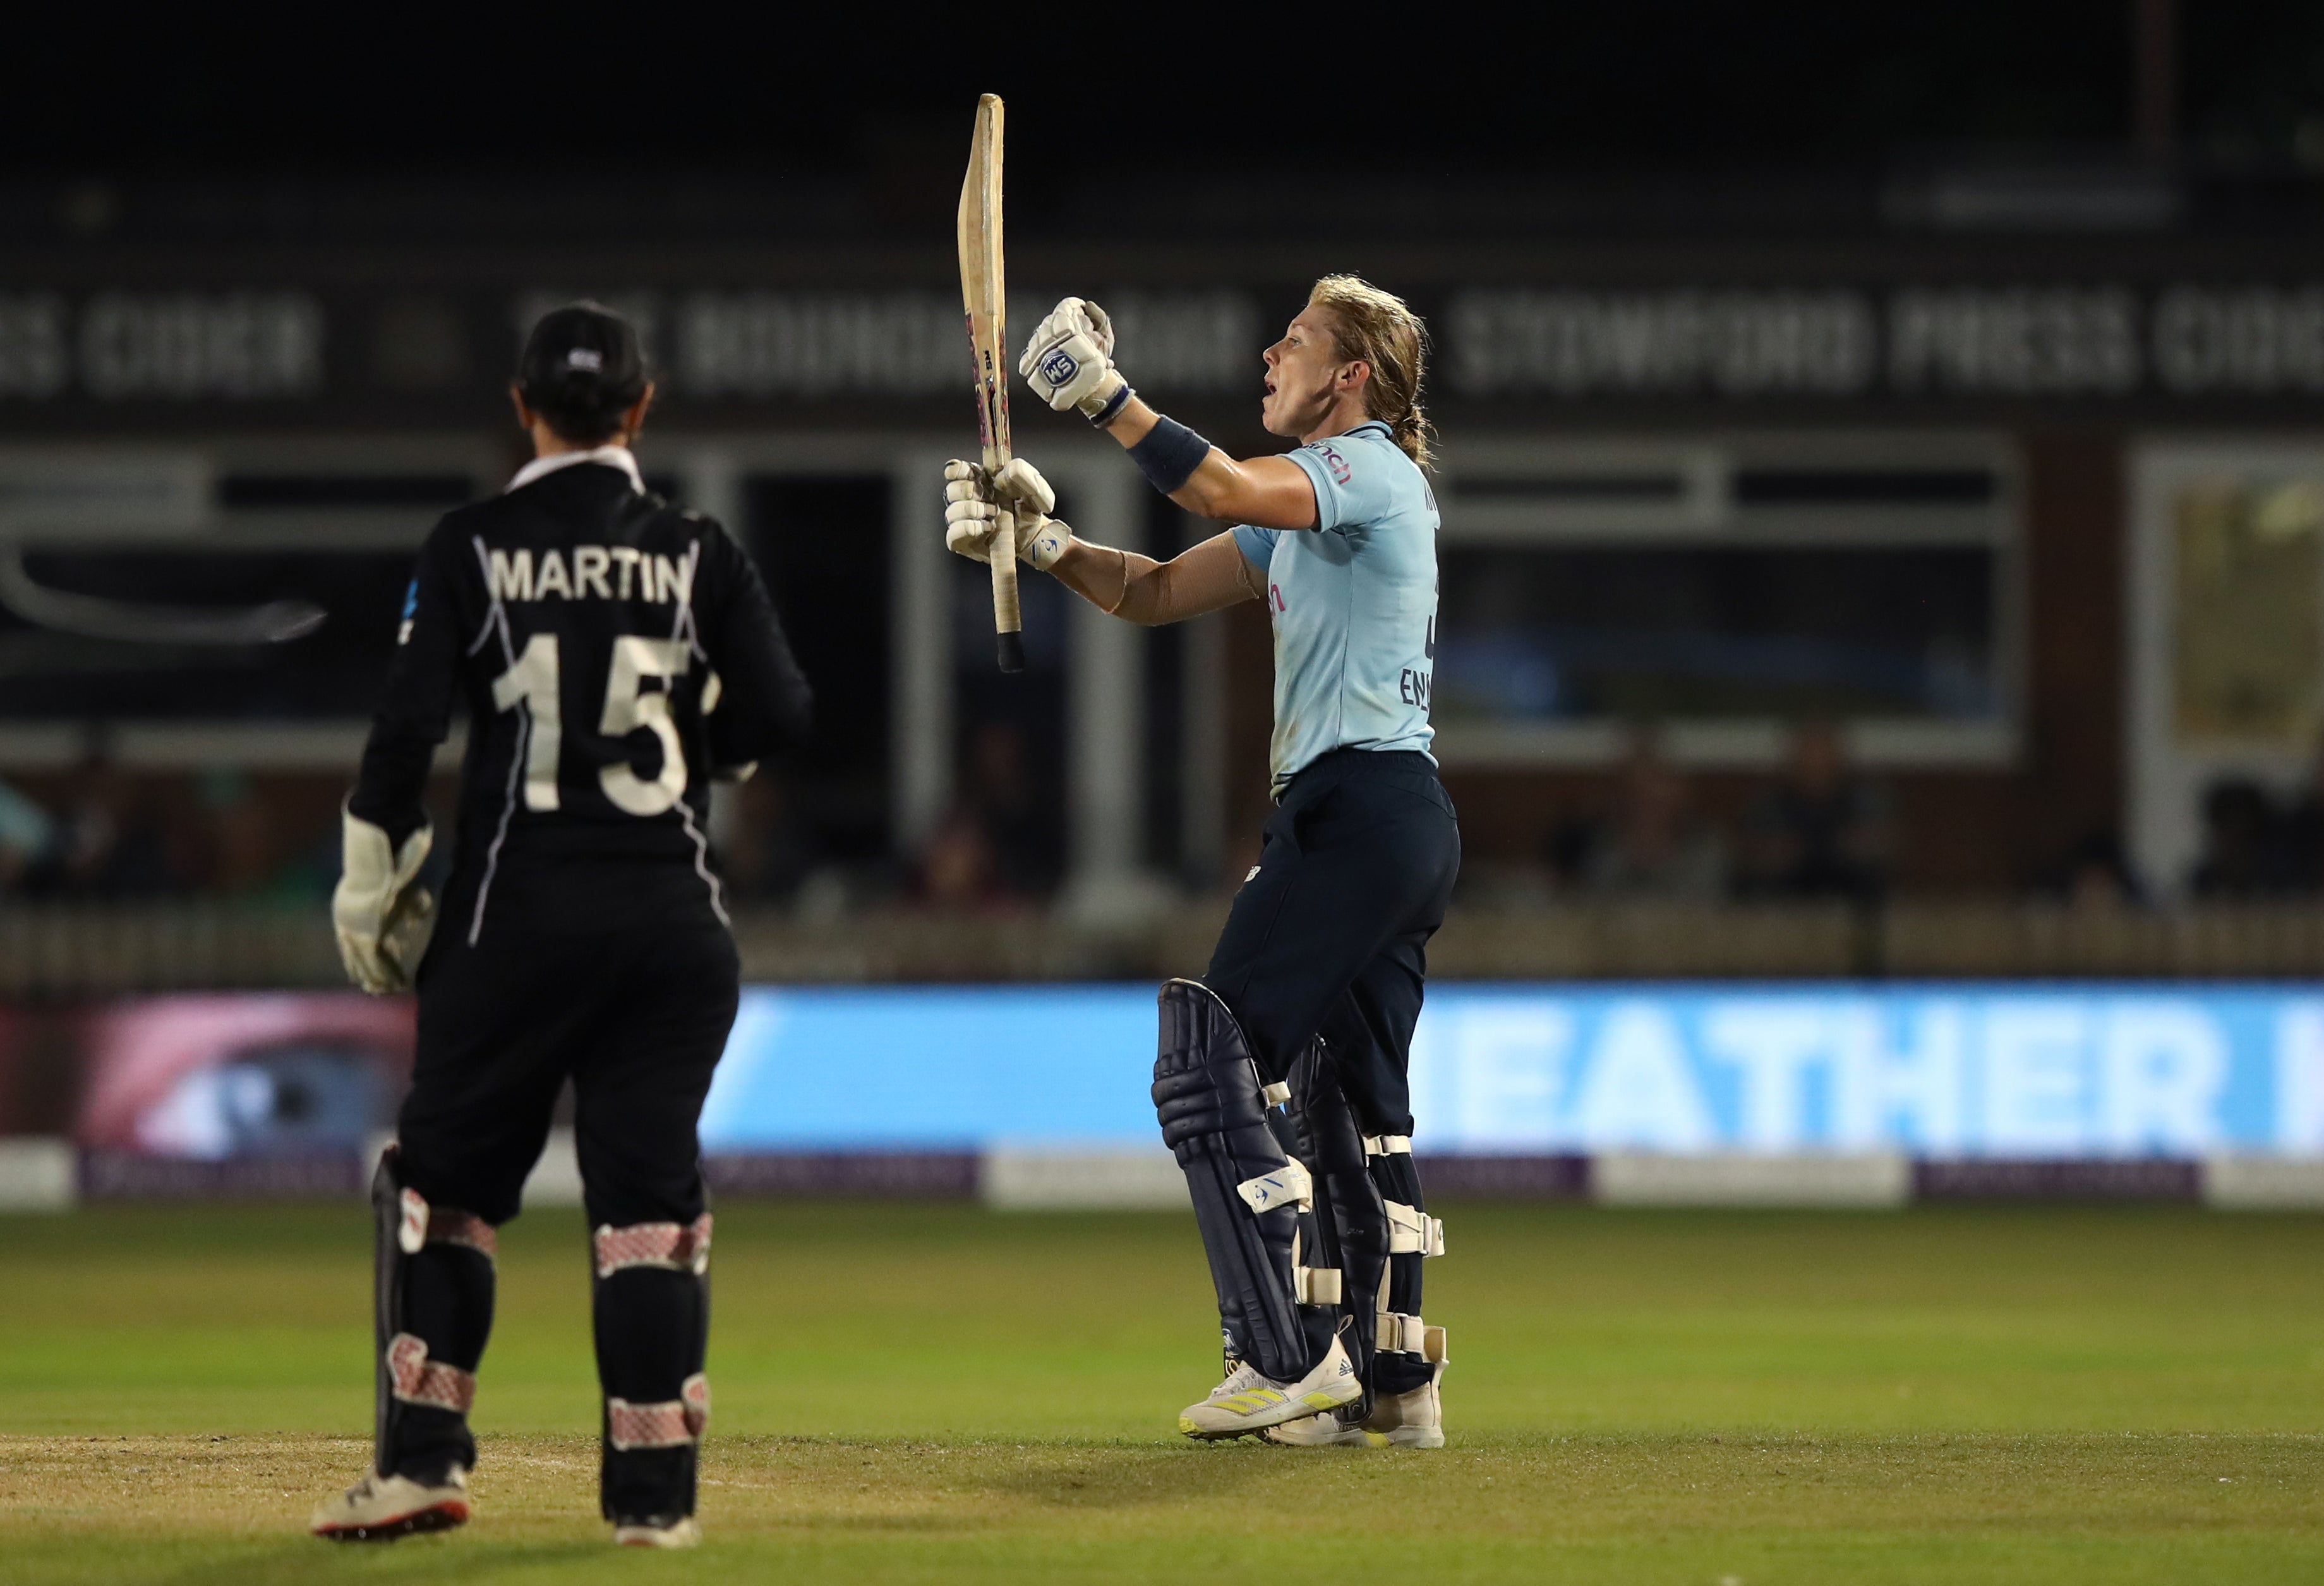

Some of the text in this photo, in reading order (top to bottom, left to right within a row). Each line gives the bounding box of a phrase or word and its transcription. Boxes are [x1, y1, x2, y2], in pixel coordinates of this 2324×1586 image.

[1889, 293, 2139, 389] PRESS
[490, 544, 690, 605] MARTIN
[491, 633, 692, 817] 15
[1407, 995, 2230, 1155] EATHER
